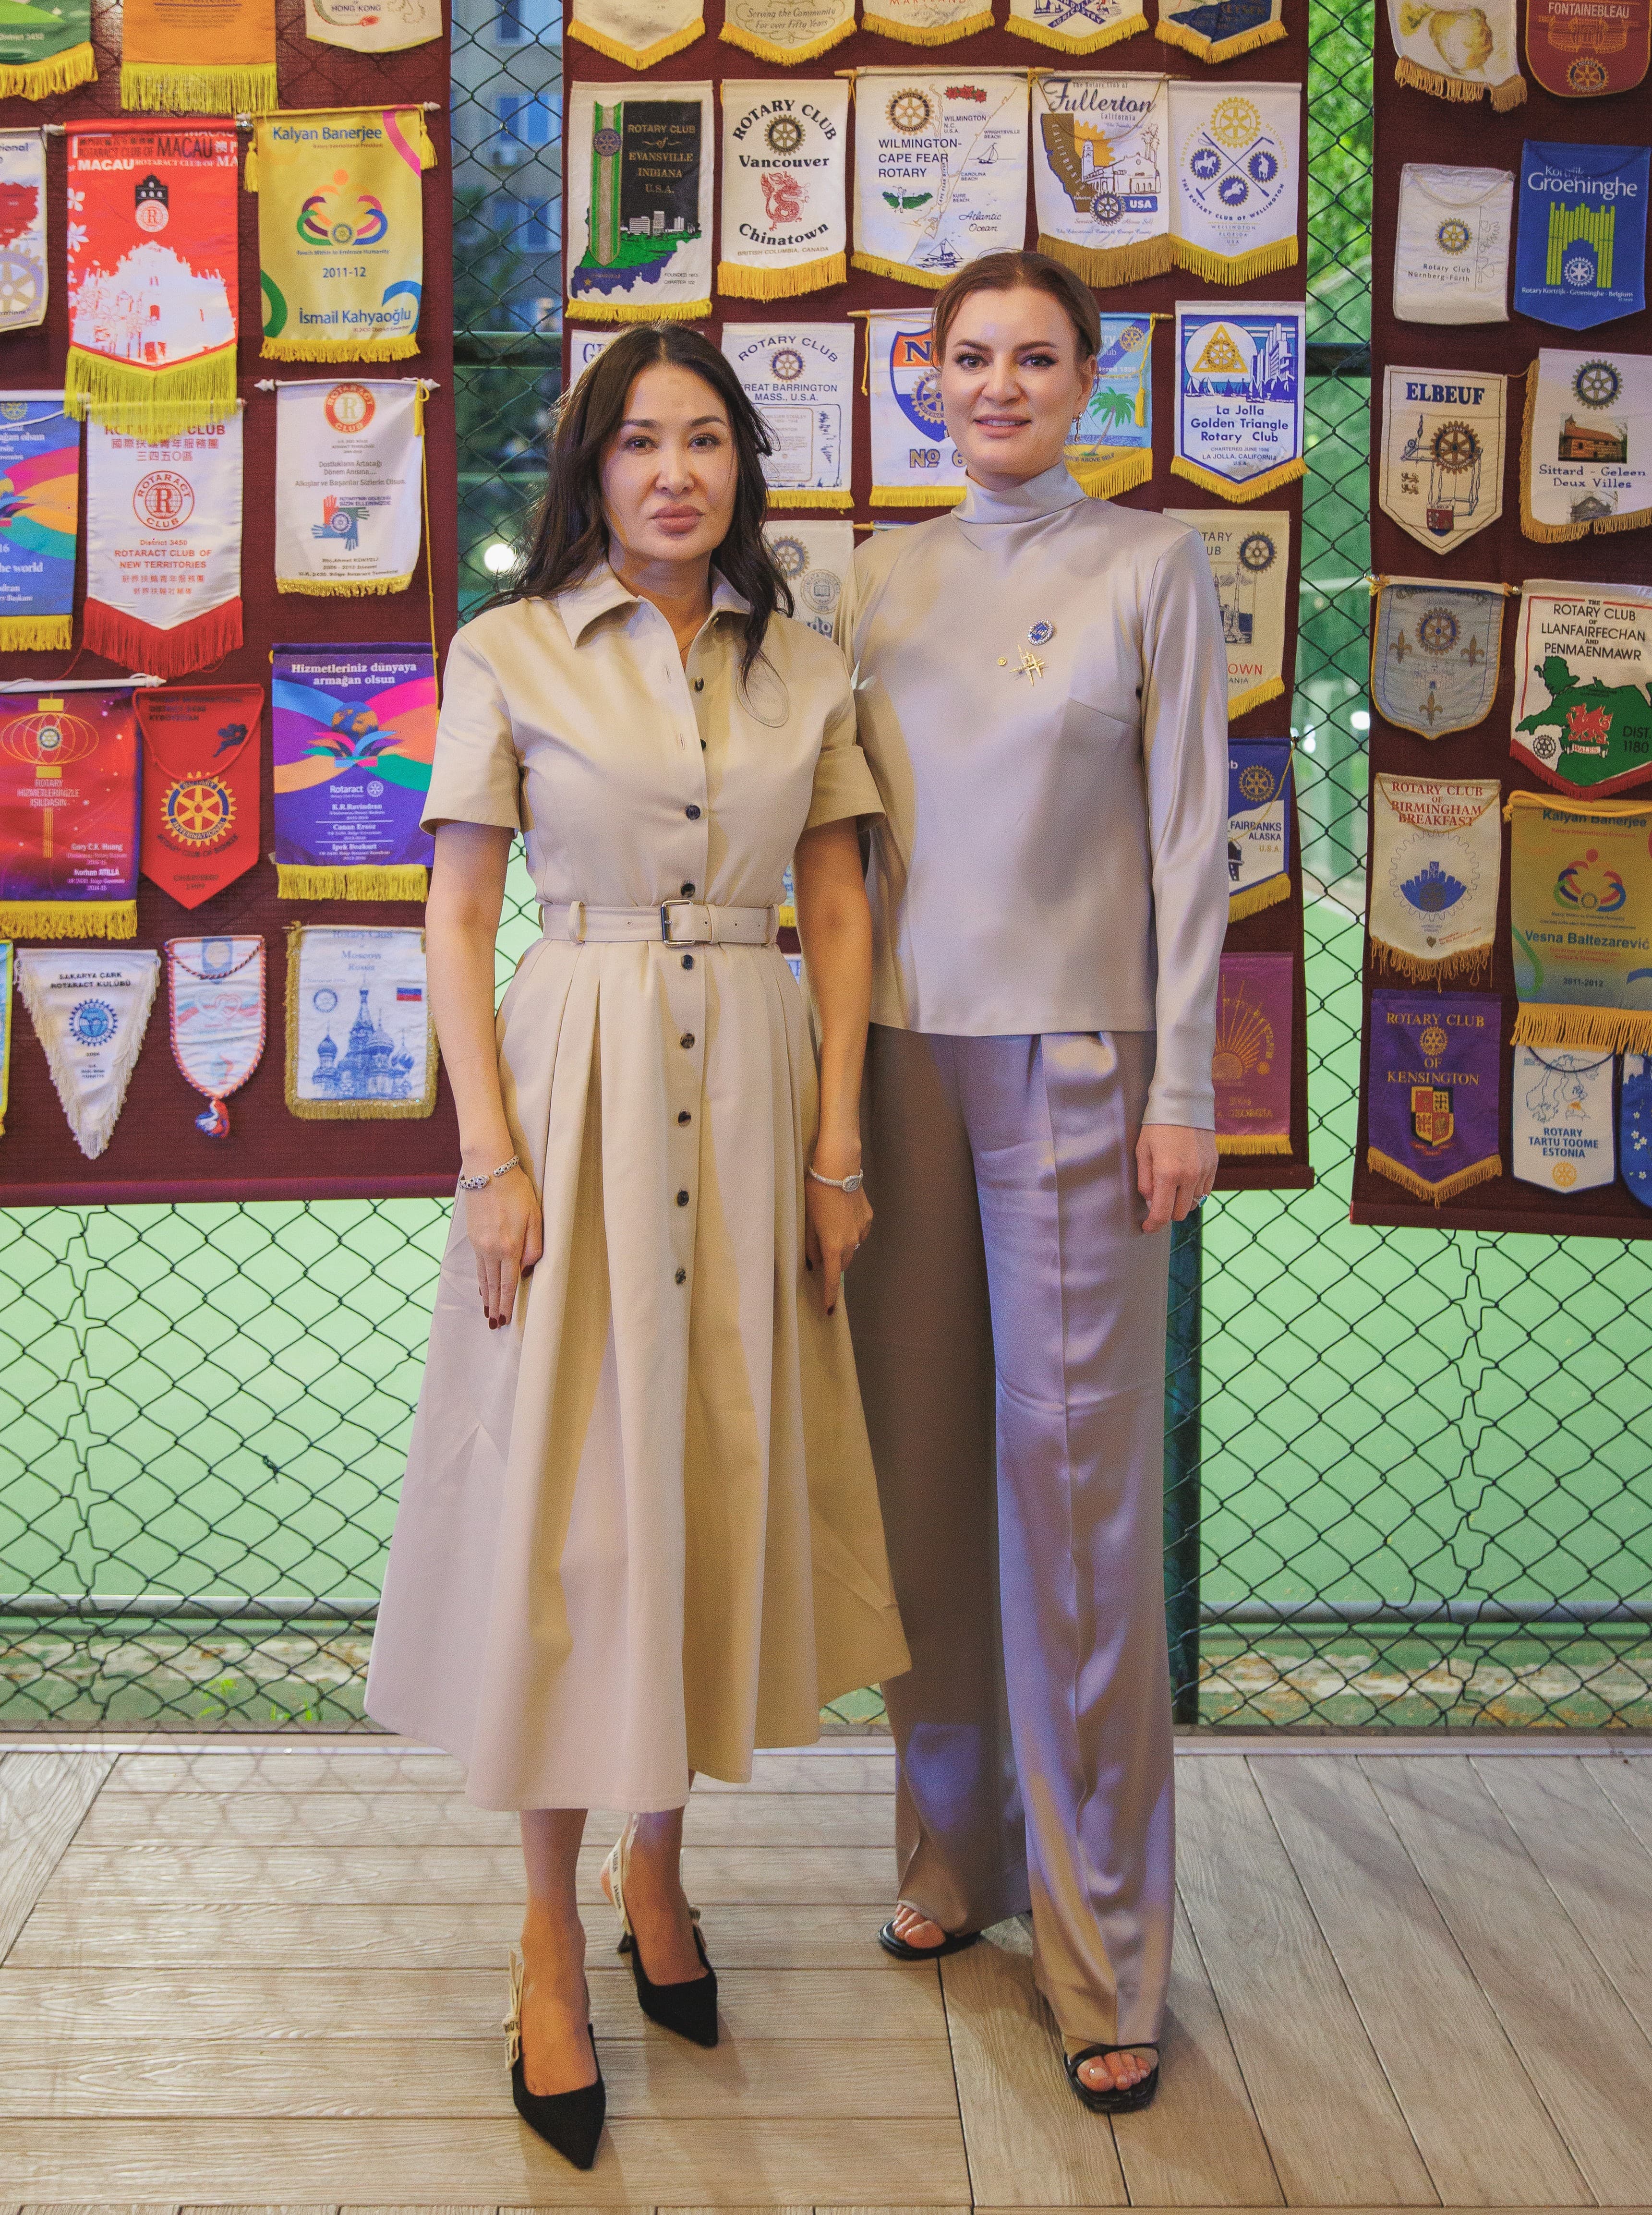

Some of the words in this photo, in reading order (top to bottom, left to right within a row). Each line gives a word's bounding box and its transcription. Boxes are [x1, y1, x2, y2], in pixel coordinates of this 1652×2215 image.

[747, 8, 776, 20] Serving
[779, 8, 792, 17] the
[793, 7, 836, 18] Community
[1548, 1, 1629, 19] FONTAINEBLEAU
[787, 20, 807, 31] Fifty
[810, 19, 828, 27] Years
[1043, 79, 1156, 113] Fullerton
[733, 99, 797, 142] ROTARY
[801, 103, 837, 141] CLUB
[1100, 113, 1136, 121] California
[272, 126, 318, 142] Kalyan
[322, 127, 382, 143] Banerjee
[627, 124, 667, 133] ROTARY
[669, 124, 696, 134] CLUB
[156, 137, 212, 158] MACAU
[657, 137, 668, 148] of
[878, 139, 962, 149] WILMINGTON-
[628, 152, 693, 162] EVANSVILLE
[739, 155, 830, 168] Vancouver
[878, 154, 912, 163] CAPE
[916, 154, 949, 163] FEAR
[77, 158, 135, 171] MACAU
[638, 168, 683, 178] INDIANA
[878, 168, 928, 178] ROTARY
[645, 184, 675, 194] U.S.A.
[1527, 171, 1638, 201] Groeninghe
[1181, 178, 1190, 193] THE
[1189, 194, 1213, 215] ROTARY
[1249, 183, 1285, 218] WELLINGTON
[1129, 199, 1152, 210] USA
[958, 211, 1002, 221] Atlantic
[738, 222, 830, 246] Chinatown
[968, 223, 998, 233] Ocean
[764, 247, 799, 255] COLUMBIA,
[323, 267, 367, 278] 2011-12
[1423, 263, 1449, 272] Rotary
[1452, 265, 1471, 274] Club
[299, 308, 338, 325] İsmail
[342, 309, 411, 325] Kahyaoğlu
[738, 336, 796, 361] ROTARY
[802, 337, 838, 363] CLUB
[772, 383, 838, 392] BARRINGTON
[755, 392, 786, 401] MASS.,
[790, 392, 819, 401] U.S.A.
[1405, 382, 1485, 406] ELBEUF
[1216, 405, 1230, 416] La
[1235, 404, 1264, 416] Jolla
[188, 425, 226, 435] CLUB
[335, 421, 364, 433] CLUB
[1191, 419, 1235, 429] Golden
[1240, 419, 1289, 432] Triangle
[1201, 432, 1242, 444] Rotary
[1252, 432, 1278, 442] Club
[1539, 465, 1584, 477] Sittard
[1601, 466, 1646, 477] Geleen
[136, 473, 192, 498] ROTARACT
[1553, 477, 1586, 488] Deux
[1593, 478, 1632, 489] Villes
[154, 488, 174, 514] R
[145, 517, 180, 529] CLUB
[12, 561, 44, 573] world
[1553, 604, 1601, 619] ROTARY
[1604, 608, 1636, 622] CLUB
[1541, 623, 1646, 642] LLANFAIRFECHAN
[1544, 642, 1642, 662] PENMAENMAWR
[291, 663, 368, 674] Hizmetleriniz
[370, 662, 417, 674] dünyaya
[313, 674, 362, 687] armağan
[365, 675, 396, 685] olsun
[1572, 746, 1599, 754] WALES
[1623, 740, 1650, 754] 1180
[34, 779, 63, 787] ROTARY
[330, 785, 364, 793] Rotaract
[1392, 781, 1442, 796] ROTARY
[1446, 782, 1483, 796] CLUB
[1391, 800, 1482, 816] BIRMINGHAM
[1398, 813, 1474, 827] BREAKFAST
[1542, 808, 1587, 823] Kalyan
[1590, 815, 1647, 829] Banerjee
[1230, 820, 1281, 831] FAIRBANKS
[1248, 832, 1281, 841] ALASKA
[1258, 844, 1281, 853] U.S.A.
[1525, 929, 1564, 944] Vesna
[1567, 932, 1651, 950] Baltezarević
[1563, 977, 1604, 987] 2011-2012
[1387, 1012, 1441, 1025] ROTARY
[1447, 1014, 1485, 1028] CLUB
[1423, 1058, 1443, 1069] OF
[1387, 1071, 1480, 1085] KENSINGTON
[1543, 1127, 1583, 1137] ROTARY
[1529, 1137, 1562, 1147] TARTU
[1564, 1138, 1598, 1149] TOOME
[1543, 1147, 1586, 1158] ESTONIA
